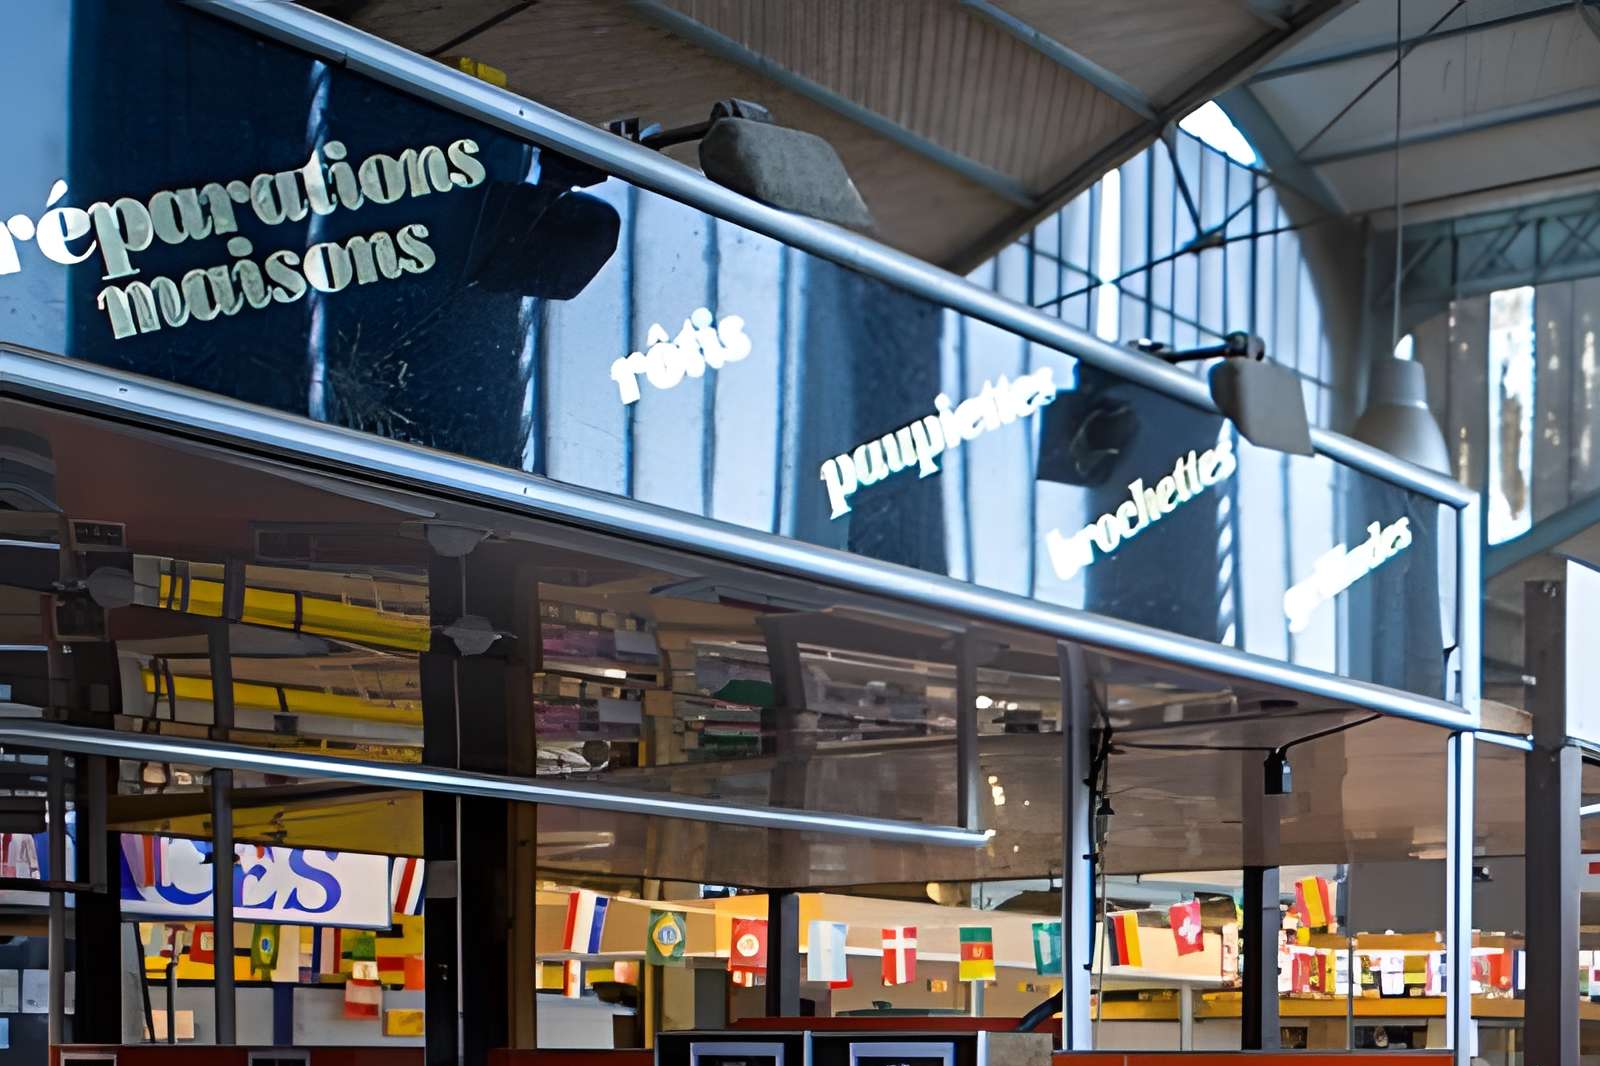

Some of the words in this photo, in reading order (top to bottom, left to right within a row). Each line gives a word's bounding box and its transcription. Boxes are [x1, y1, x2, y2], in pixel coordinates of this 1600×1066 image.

[97, 223, 436, 340] maisons
[820, 366, 1057, 520] paupiettes
[1046, 440, 1237, 580] brochettes
